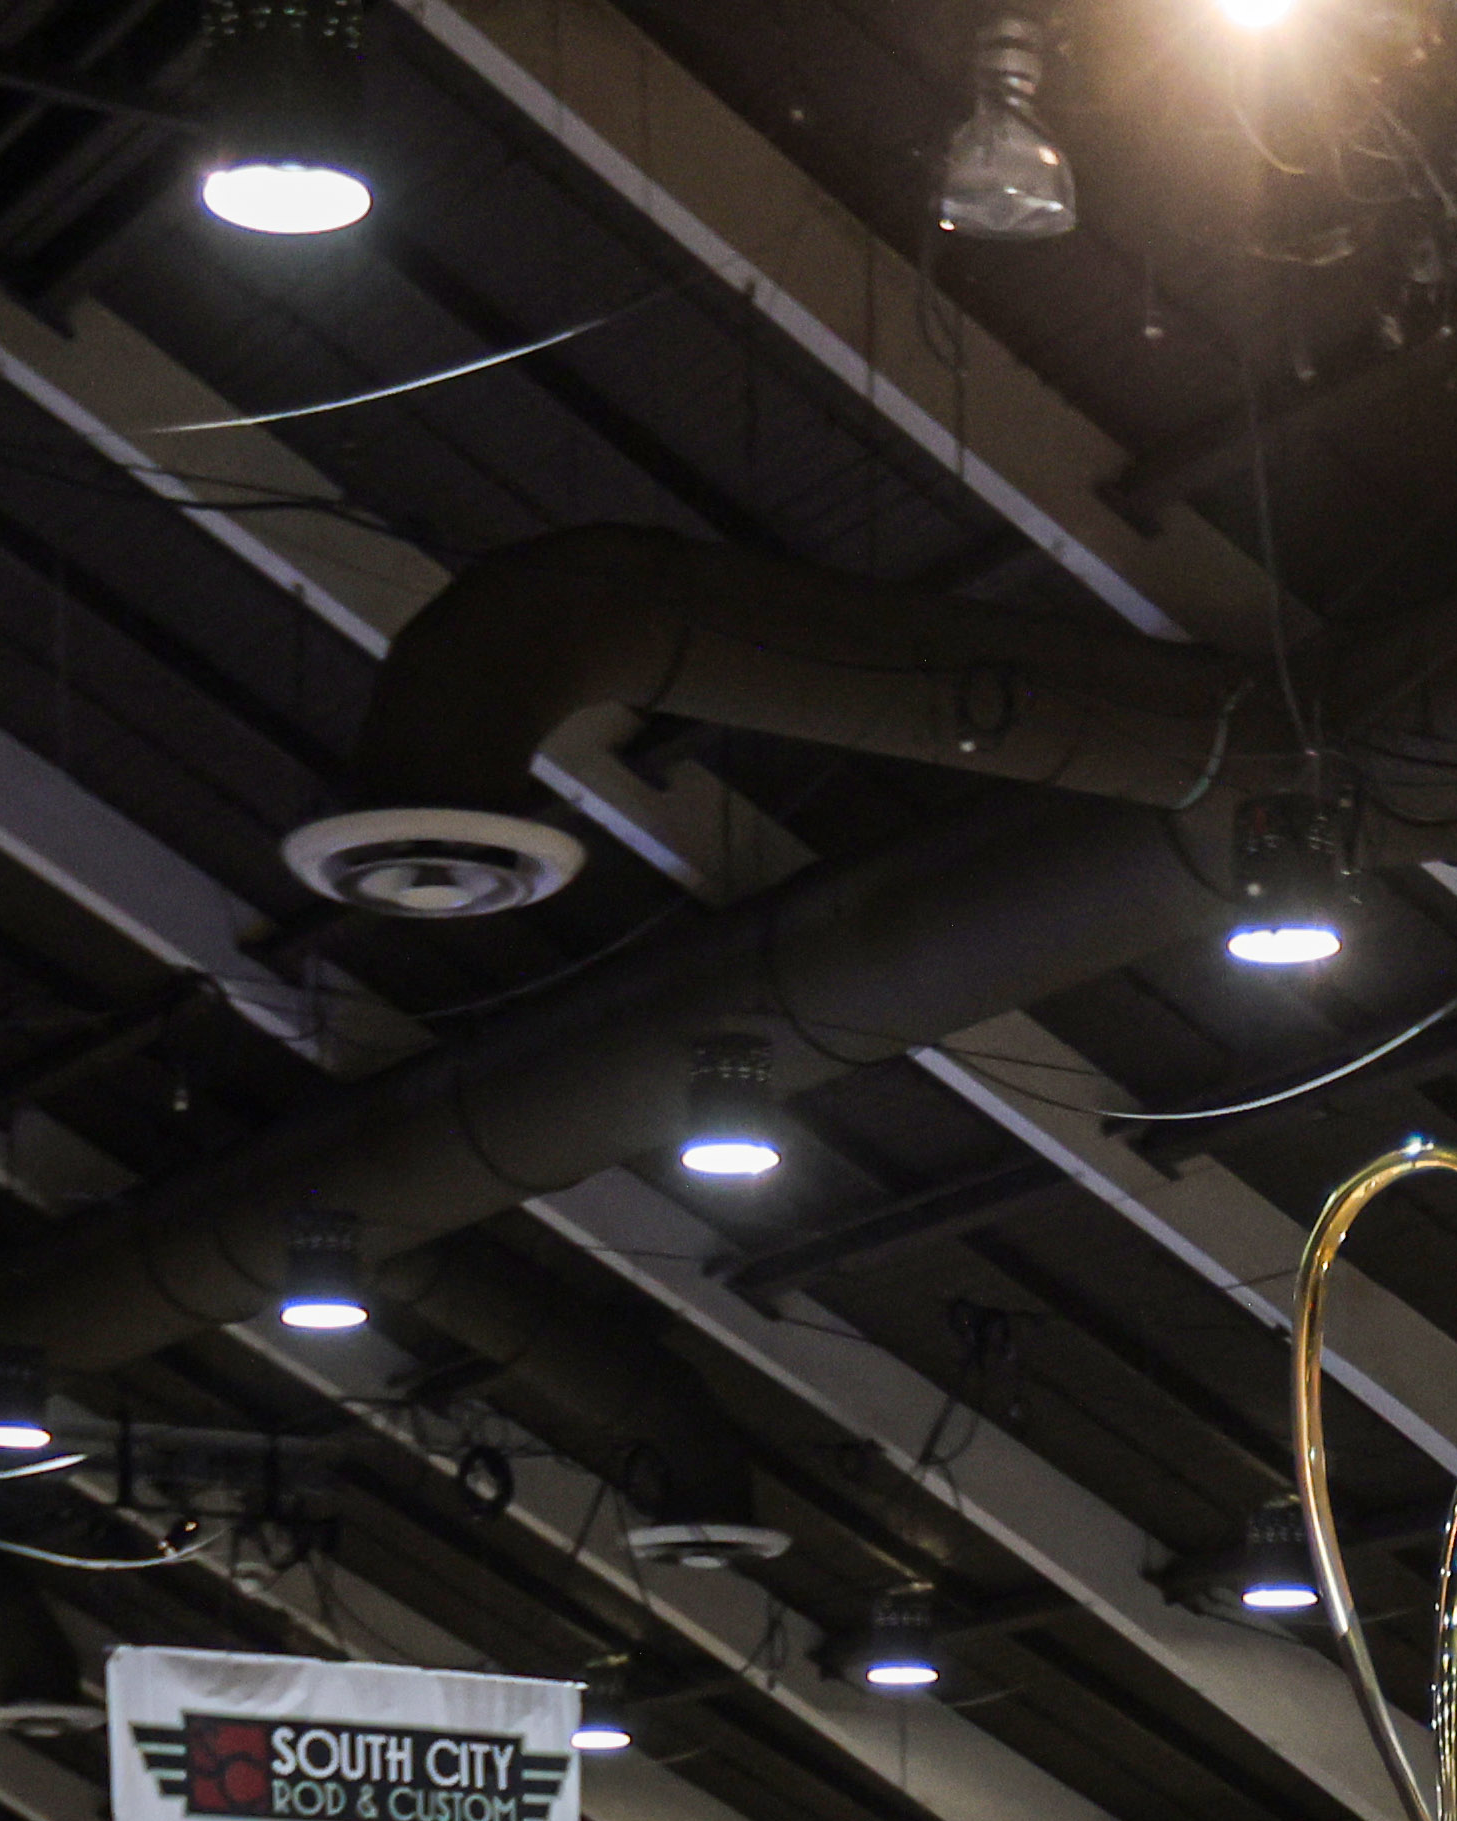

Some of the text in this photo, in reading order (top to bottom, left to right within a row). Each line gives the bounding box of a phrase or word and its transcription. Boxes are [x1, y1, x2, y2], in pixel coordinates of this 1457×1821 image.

[271, 1726, 515, 1791] SOUTH CITY
[271, 1779, 347, 1817] ROD
[356, 1783, 379, 1820] &
